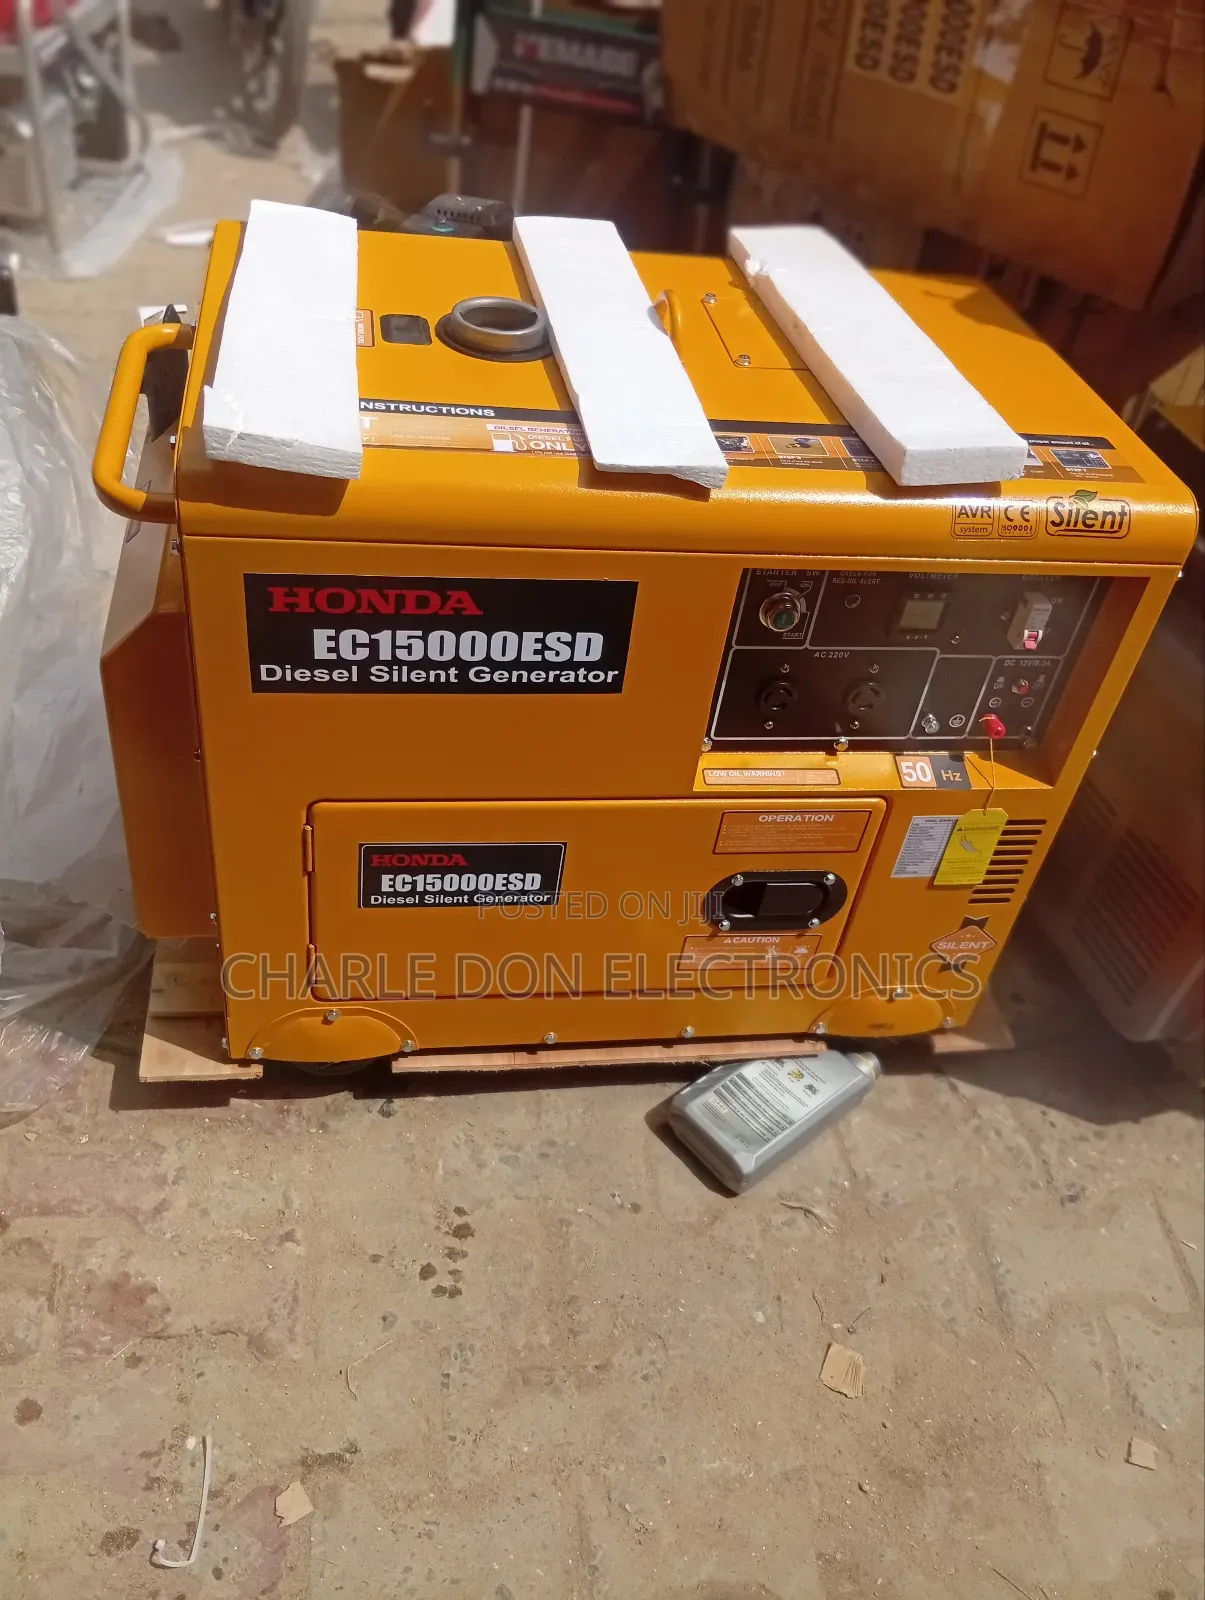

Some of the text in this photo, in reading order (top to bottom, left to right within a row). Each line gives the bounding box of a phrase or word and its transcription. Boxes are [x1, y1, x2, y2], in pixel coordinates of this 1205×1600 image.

[360, 401, 496, 417] NSTRUCTIONS
[529, 440, 588, 452] ONLY
[956, 505, 992, 519] AVR
[1049, 502, 1128, 531] Silent
[959, 525, 988, 534] system
[1001, 524, 1034, 532] ISO9001
[755, 569, 798, 577] STARTER
[267, 586, 483, 616] HONDA
[313, 628, 604, 663] EC15000ESD
[827, 651, 851, 659] 220V
[1003, 659, 1016, 667] DC
[260, 664, 619, 684] Diesel Silent Generator
[707, 770, 729, 778] LOW
[728, 770, 742, 778] OIL
[900, 761, 963, 783] 50 Hz
[758, 814, 835, 823] OPERATION
[371, 853, 469, 867] HONDA
[381, 873, 542, 892] EC15000ESD
[370, 893, 551, 905] Diesel Silent Generator
[732, 936, 781, 944] CAUTION
[937, 941, 991, 950] SILENT
